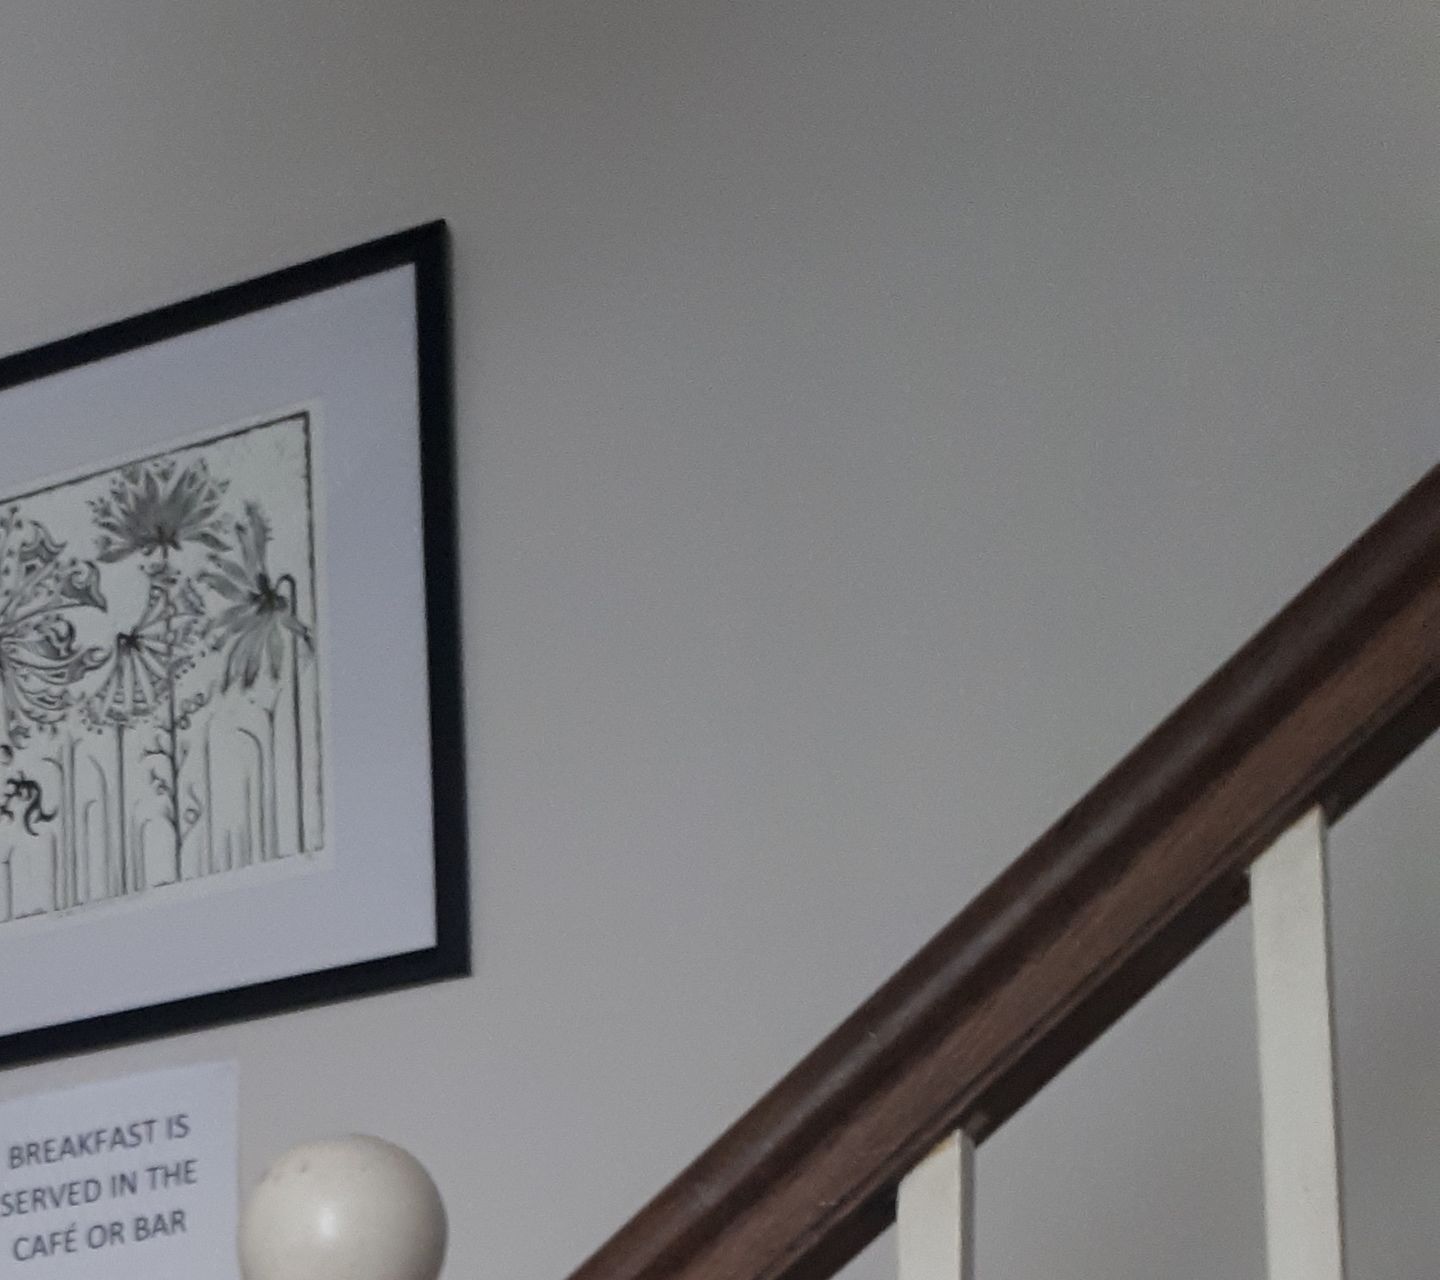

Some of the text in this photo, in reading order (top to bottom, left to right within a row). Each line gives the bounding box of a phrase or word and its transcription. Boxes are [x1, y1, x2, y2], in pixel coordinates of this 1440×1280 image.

[8, 1113, 192, 1170] BREAKFAST IS
[0, 1159, 199, 1218] SERVED IN THE
[12, 1209, 188, 1262] CAFÉ OR BAR
